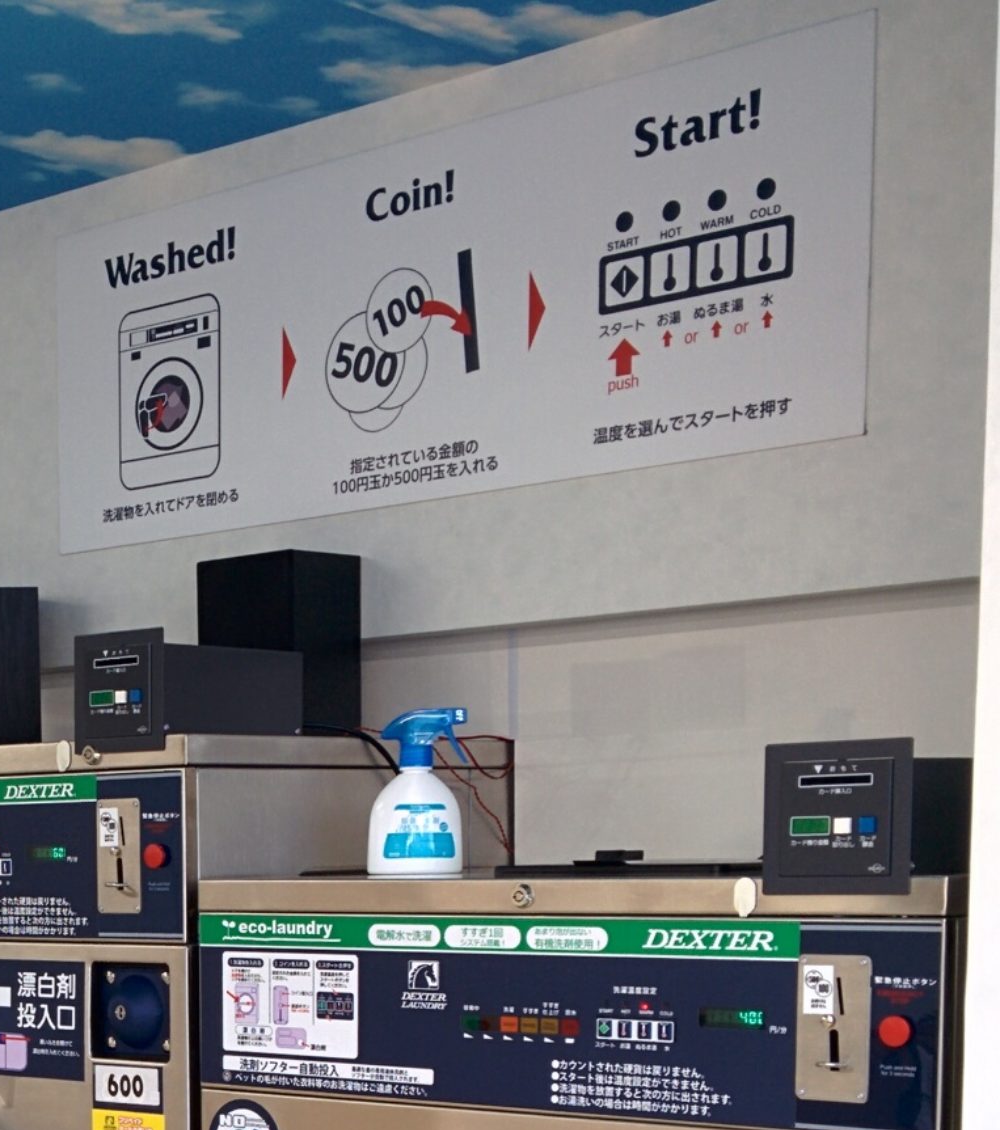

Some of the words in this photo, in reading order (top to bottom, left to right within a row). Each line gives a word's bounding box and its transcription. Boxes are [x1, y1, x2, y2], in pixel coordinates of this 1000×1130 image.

[634, 88, 761, 158] Start!
[366, 169, 455, 222] Coin!
[607, 236, 640, 252] START
[660, 227, 682, 240] HOT
[700, 215, 734, 231] WARM
[750, 204, 781, 220] COLD
[105, 226, 236, 289] Washed!
[373, 285, 426, 336] 100
[599, 319, 645, 338] スタート
[657, 311, 681, 327] お湯
[693, 298, 744, 319] ぬるま湯
[760, 293, 773, 307] 水
[684, 331, 699, 344] or
[734, 321, 749, 335] or
[331, 341, 398, 388] 500
[607, 374, 640, 395] push
[593, 397, 792, 444] 温度を選んでスタートを押す
[350, 439, 478, 474] 指定されている金額の
[333, 456, 499, 494] 100円玉か500円玉を入れる
[103, 489, 239, 523] 洗濯物を入れてドアを閉める
[4, 783, 74, 800] DEXTER
[238, 920, 333, 939] eco-laundry
[376, 929, 432, 942] 電解水で洗濯
[460, 928, 504, 938] すすぎ1回
[642, 929, 773, 951] DEXTER
[16, 971, 77, 1000] 漂白剤
[874, 976, 937, 987] 緊急停止ボタン
[401, 992, 447, 1001] DEXTER
[401, 1001, 447, 1010] LAUNDRY
[16, 1003, 77, 1031] 投入口
[239, 1058, 339, 1077] 洗剤ソフター自動投入
[107, 1073, 144, 1098] 600
[219, 1114, 246, 1128] NO
